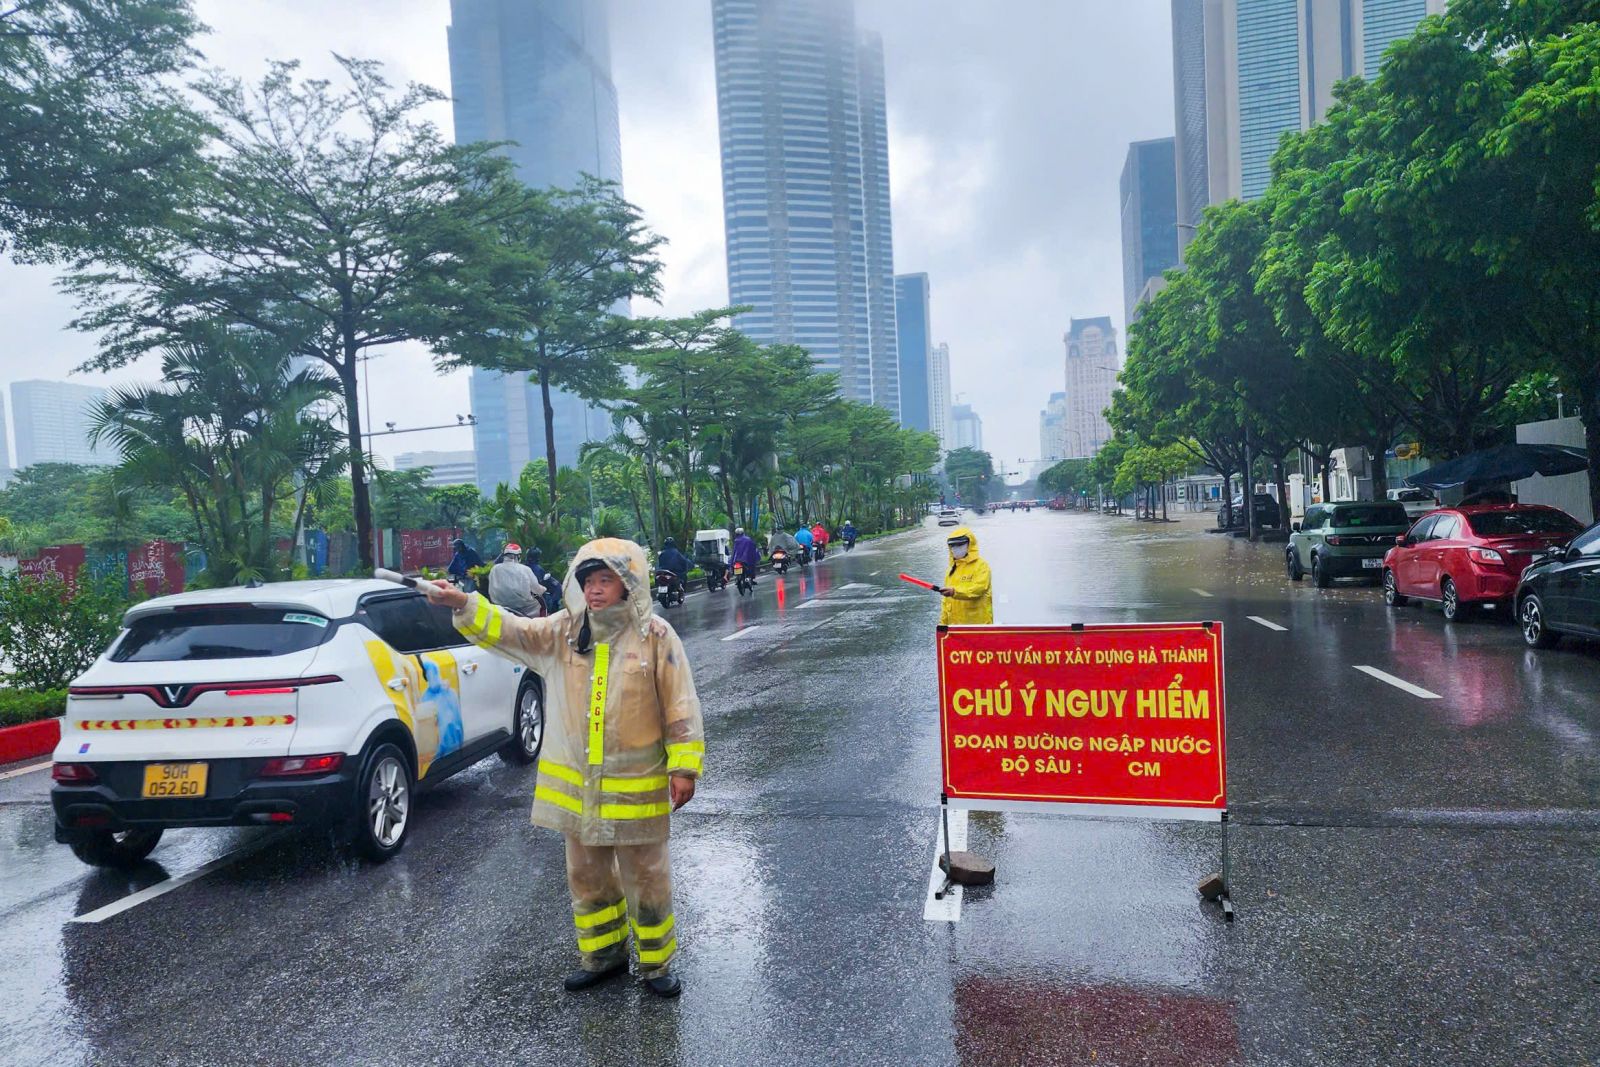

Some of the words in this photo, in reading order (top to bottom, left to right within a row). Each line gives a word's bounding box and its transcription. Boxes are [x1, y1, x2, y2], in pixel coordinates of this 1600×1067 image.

[950, 650, 972, 664] CTY
[977, 650, 993, 664] CP
[996, 649, 1012, 664] TƯ
[1014, 645, 1041, 664] VẤN
[1045, 650, 1061, 664] ĐT
[1065, 647, 1091, 664] XÂY
[1095, 649, 1134, 668] DỰNG
[1138, 645, 1158, 664] HÀ
[1161, 645, 1208, 663] THÀNH
[952, 681, 1012, 716] CHÚ
[1019, 681, 1036, 716] Ý
[1046, 690, 1128, 718] NGUY
[1137, 673, 1210, 719] HIỂM
[954, 735, 1008, 752] ĐOẠN
[1014, 732, 1083, 751] ĐƯỜNG
[1089, 734, 1145, 756] NGẬP
[1151, 735, 1212, 754] NƯỚC
[1001, 755, 1029, 777] ĐỘ
[1035, 755, 1070, 773] SÂU
[1128, 762, 1160, 777] CM
[150, 781, 198, 795] 052.60
